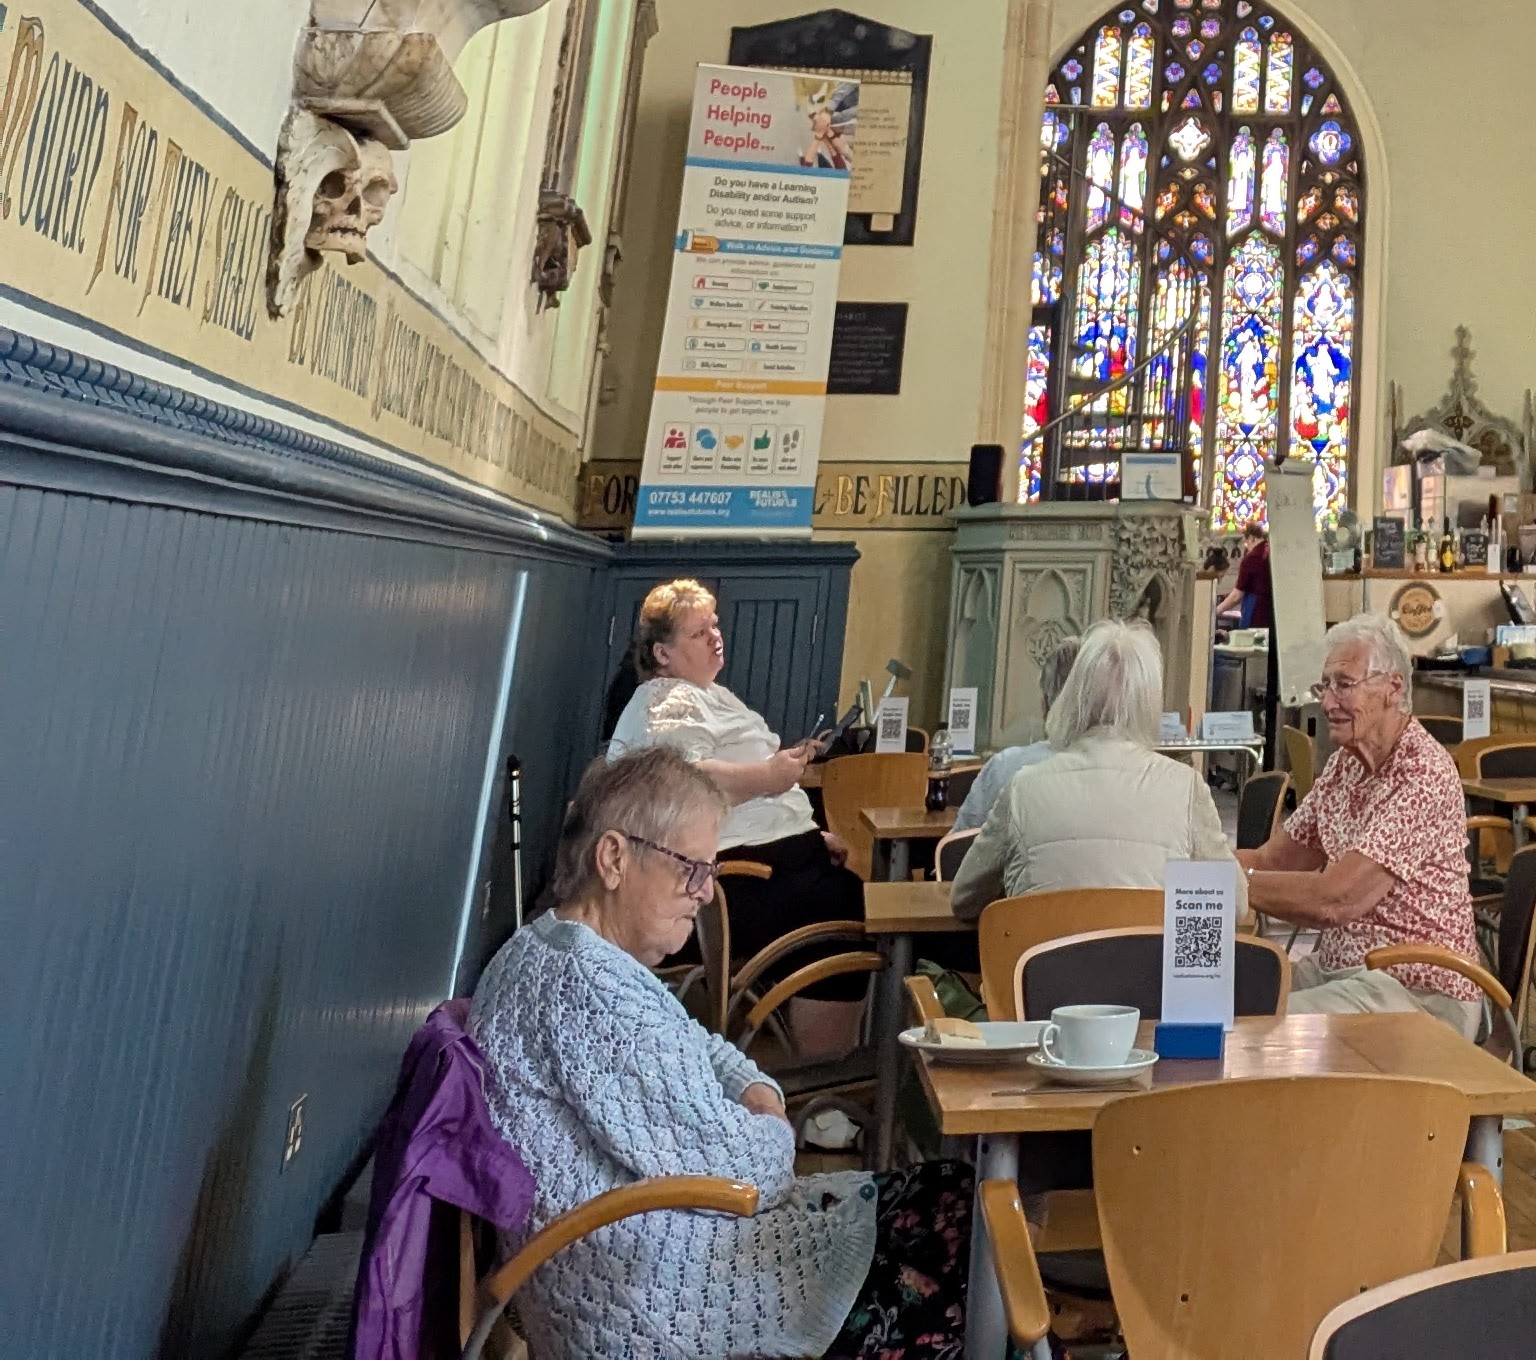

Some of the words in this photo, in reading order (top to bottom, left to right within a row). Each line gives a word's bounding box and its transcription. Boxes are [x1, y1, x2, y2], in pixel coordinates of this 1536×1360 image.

[709, 78, 768, 102] People
[706, 104, 772, 130] Helping
[703, 129, 776, 153] People...
[714, 176, 728, 186] Do
[729, 179, 747, 189] you
[748, 180, 770, 189] have
[779, 181, 817, 194] Learning
[709, 188, 751, 201] Disability
[752, 193, 782, 202] and/or
[782, 194, 819, 205] Autism?
[85, 101, 158, 296] FOR
[137, 137, 218, 318] THEY
[706, 204, 720, 214] Do
[721, 208, 737, 217] you
[738, 208, 759, 216] need
[648, 491, 686, 504] 07753
[688, 491, 732, 505] 447607
[834, 475, 870, 517] BE
[873, 474, 967, 523] FILLED
[1195, 887, 1215, 896] about
[1175, 899, 1203, 911] Scan
[1205, 902, 1224, 910] me
